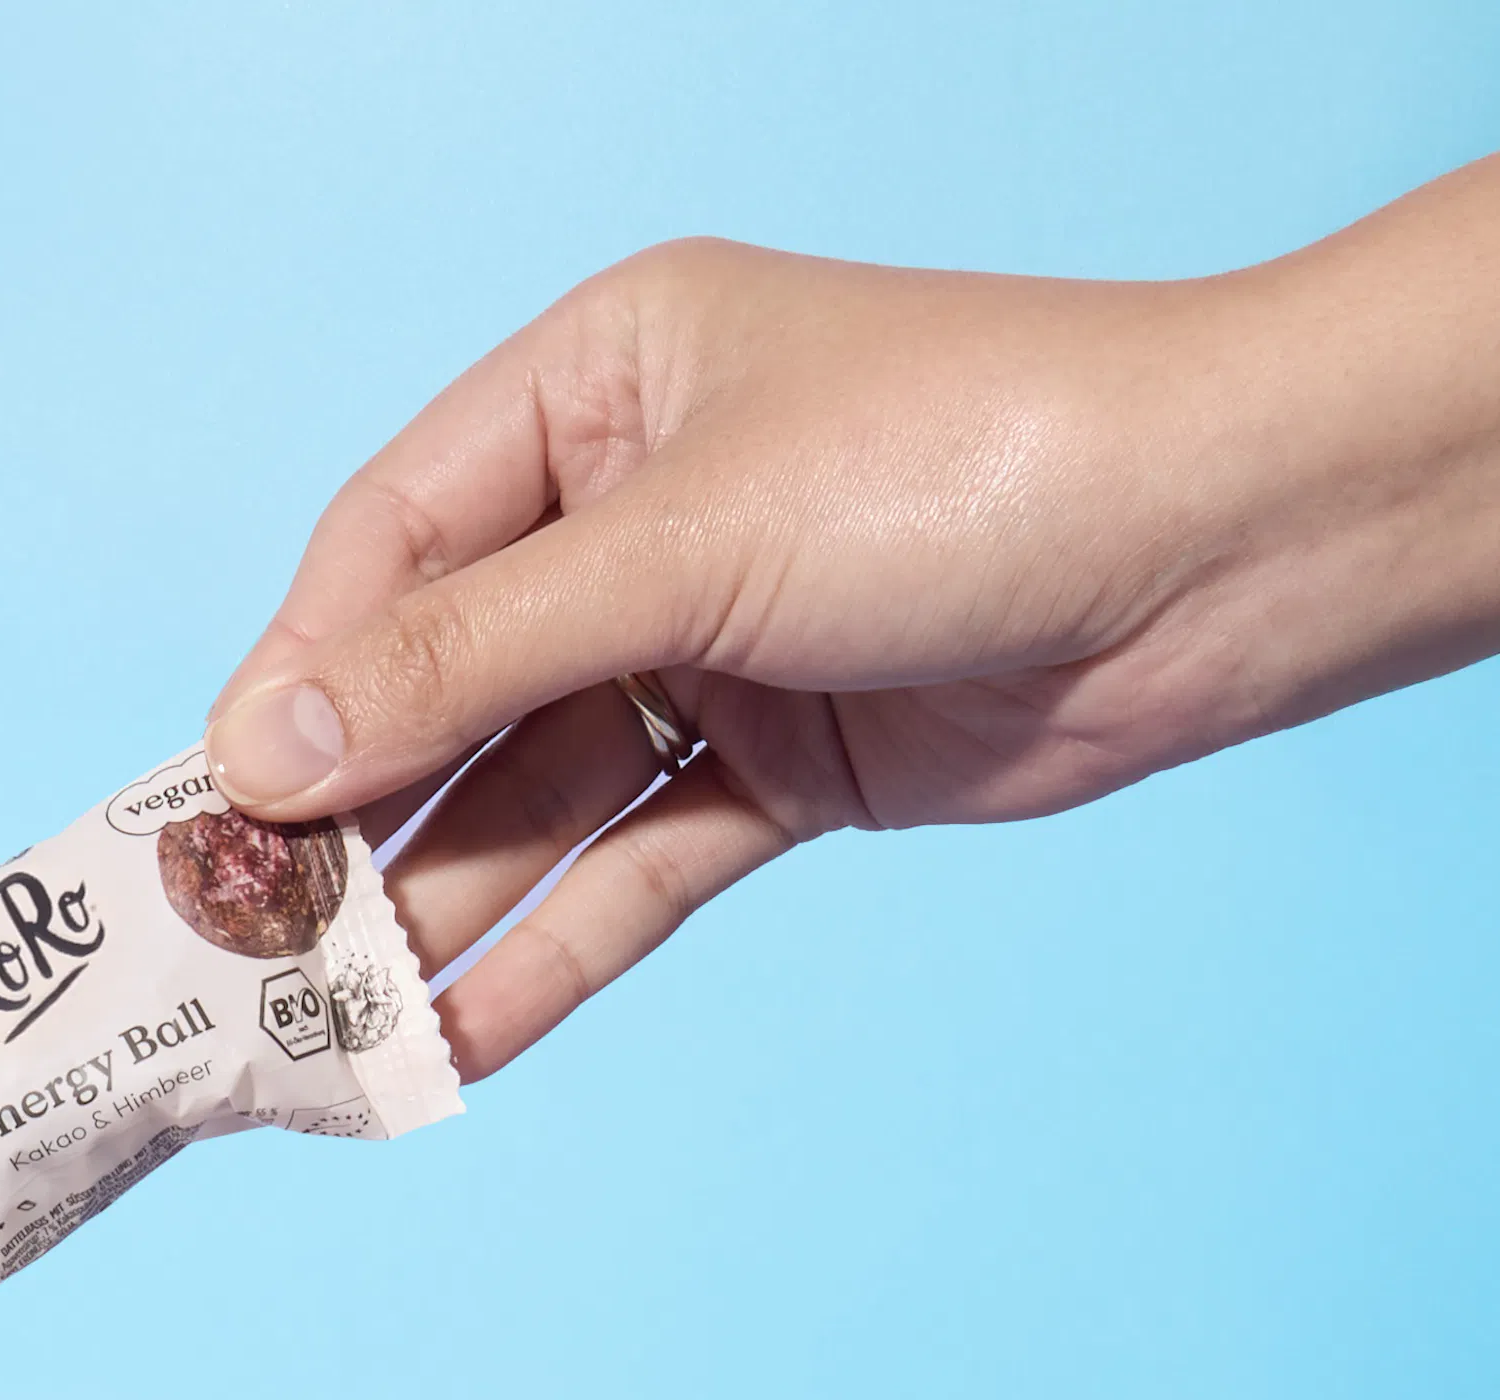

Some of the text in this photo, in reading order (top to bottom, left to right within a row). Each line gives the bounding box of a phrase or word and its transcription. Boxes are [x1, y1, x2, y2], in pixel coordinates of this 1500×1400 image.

[118, 998, 216, 1064] Ball
[10, 1126, 87, 1171] Kakao
[92, 1111, 111, 1129] &
[113, 1060, 213, 1118] Himbeer
